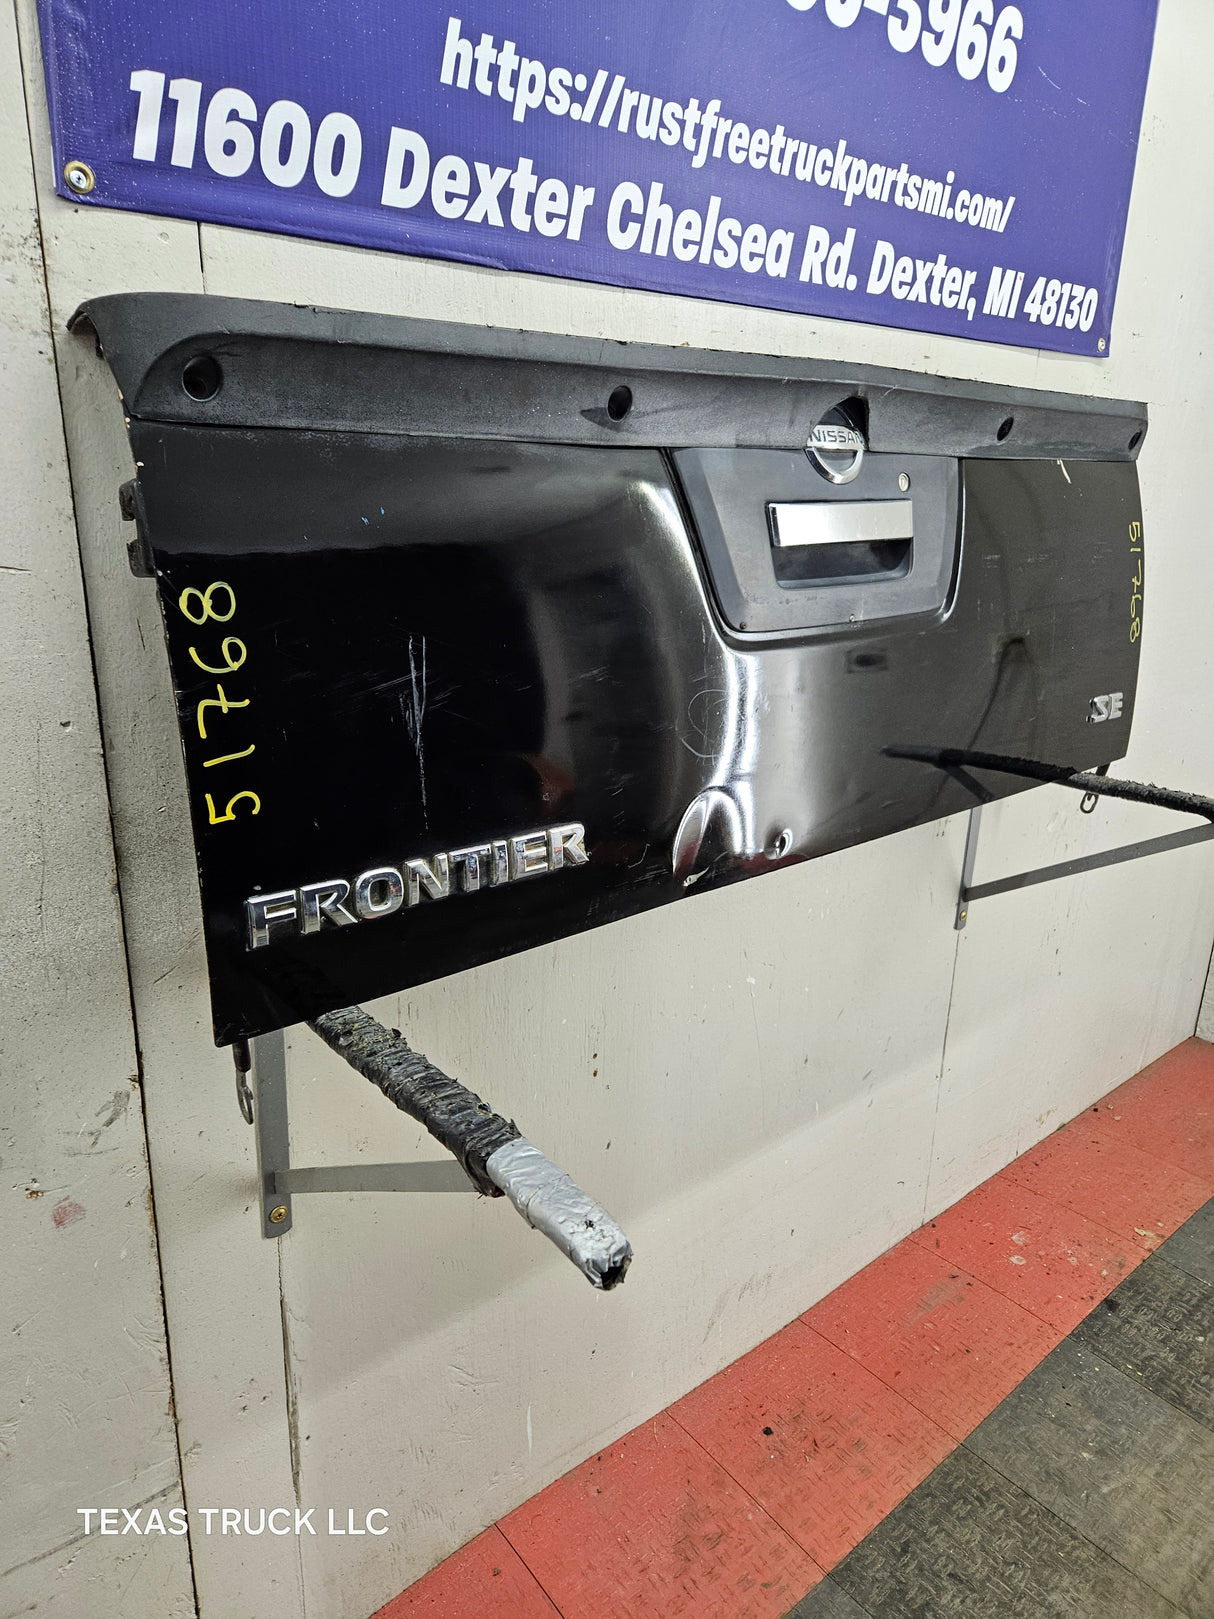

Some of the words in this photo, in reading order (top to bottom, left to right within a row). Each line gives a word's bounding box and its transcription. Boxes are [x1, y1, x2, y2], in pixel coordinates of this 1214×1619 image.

[785, 0, 1024, 93] -3966
[440, 17, 1017, 234] https://rustfreetruckpartsmi.com/
[130, 69, 363, 198] 11600
[381, 126, 596, 242] Dexter
[605, 180, 796, 280] Chelsea
[799, 225, 858, 291] Rd.
[866, 239, 978, 321] Dexter,
[982, 266, 1026, 319] MI
[1023, 276, 1099, 333] 48130
[808, 429, 864, 444] NISSAN
[1128, 521, 1142, 643] 51768
[179, 581, 261, 825] 51768
[1086, 692, 1124, 724] SE
[245, 822, 590, 952] FRONTIER
